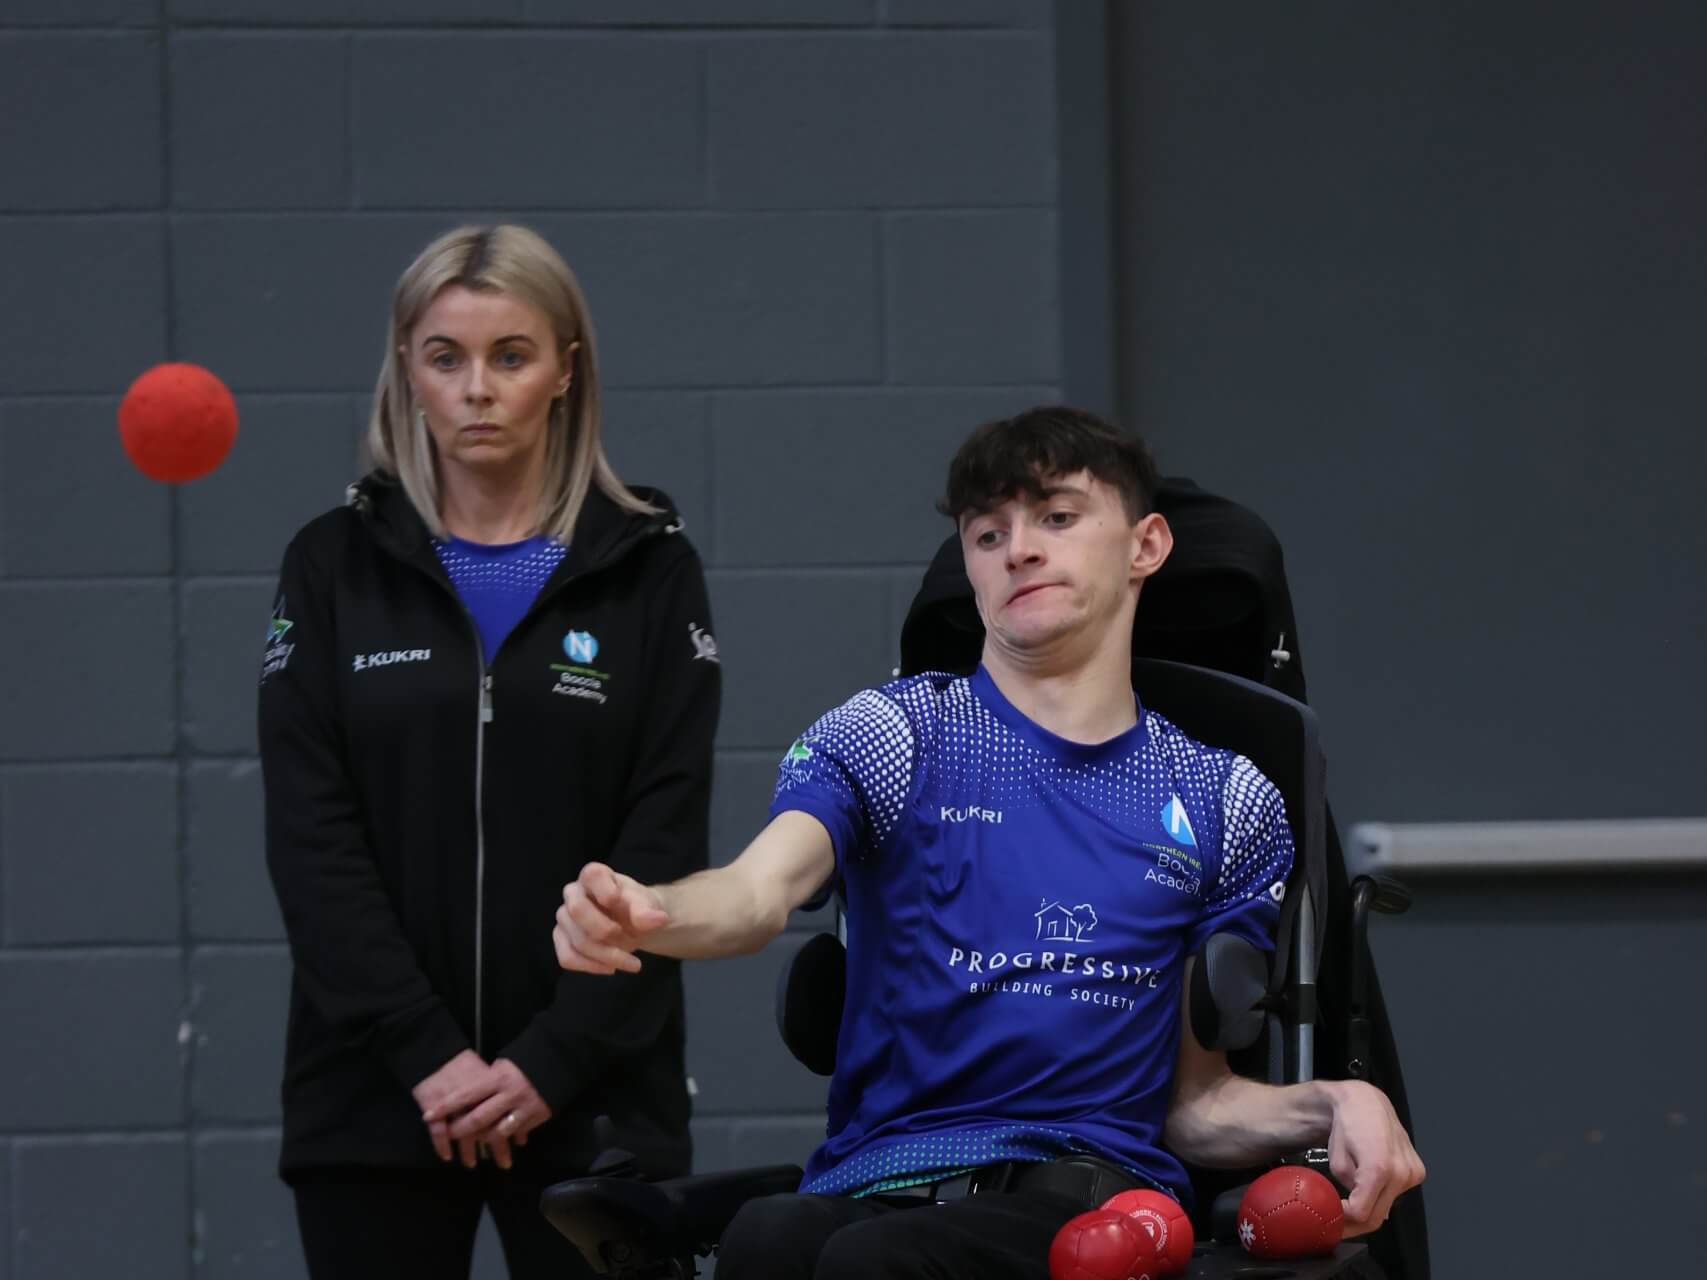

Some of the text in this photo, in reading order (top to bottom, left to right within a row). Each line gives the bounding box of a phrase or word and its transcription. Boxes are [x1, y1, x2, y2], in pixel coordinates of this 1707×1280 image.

[367, 649, 431, 668] KUKRI
[552, 682, 607, 704] Academy
[940, 805, 1003, 823] KUKRI
[949, 947, 1161, 988] PROGRESSIVE
[969, 980, 1136, 1011] BUILDING SOCIETY
